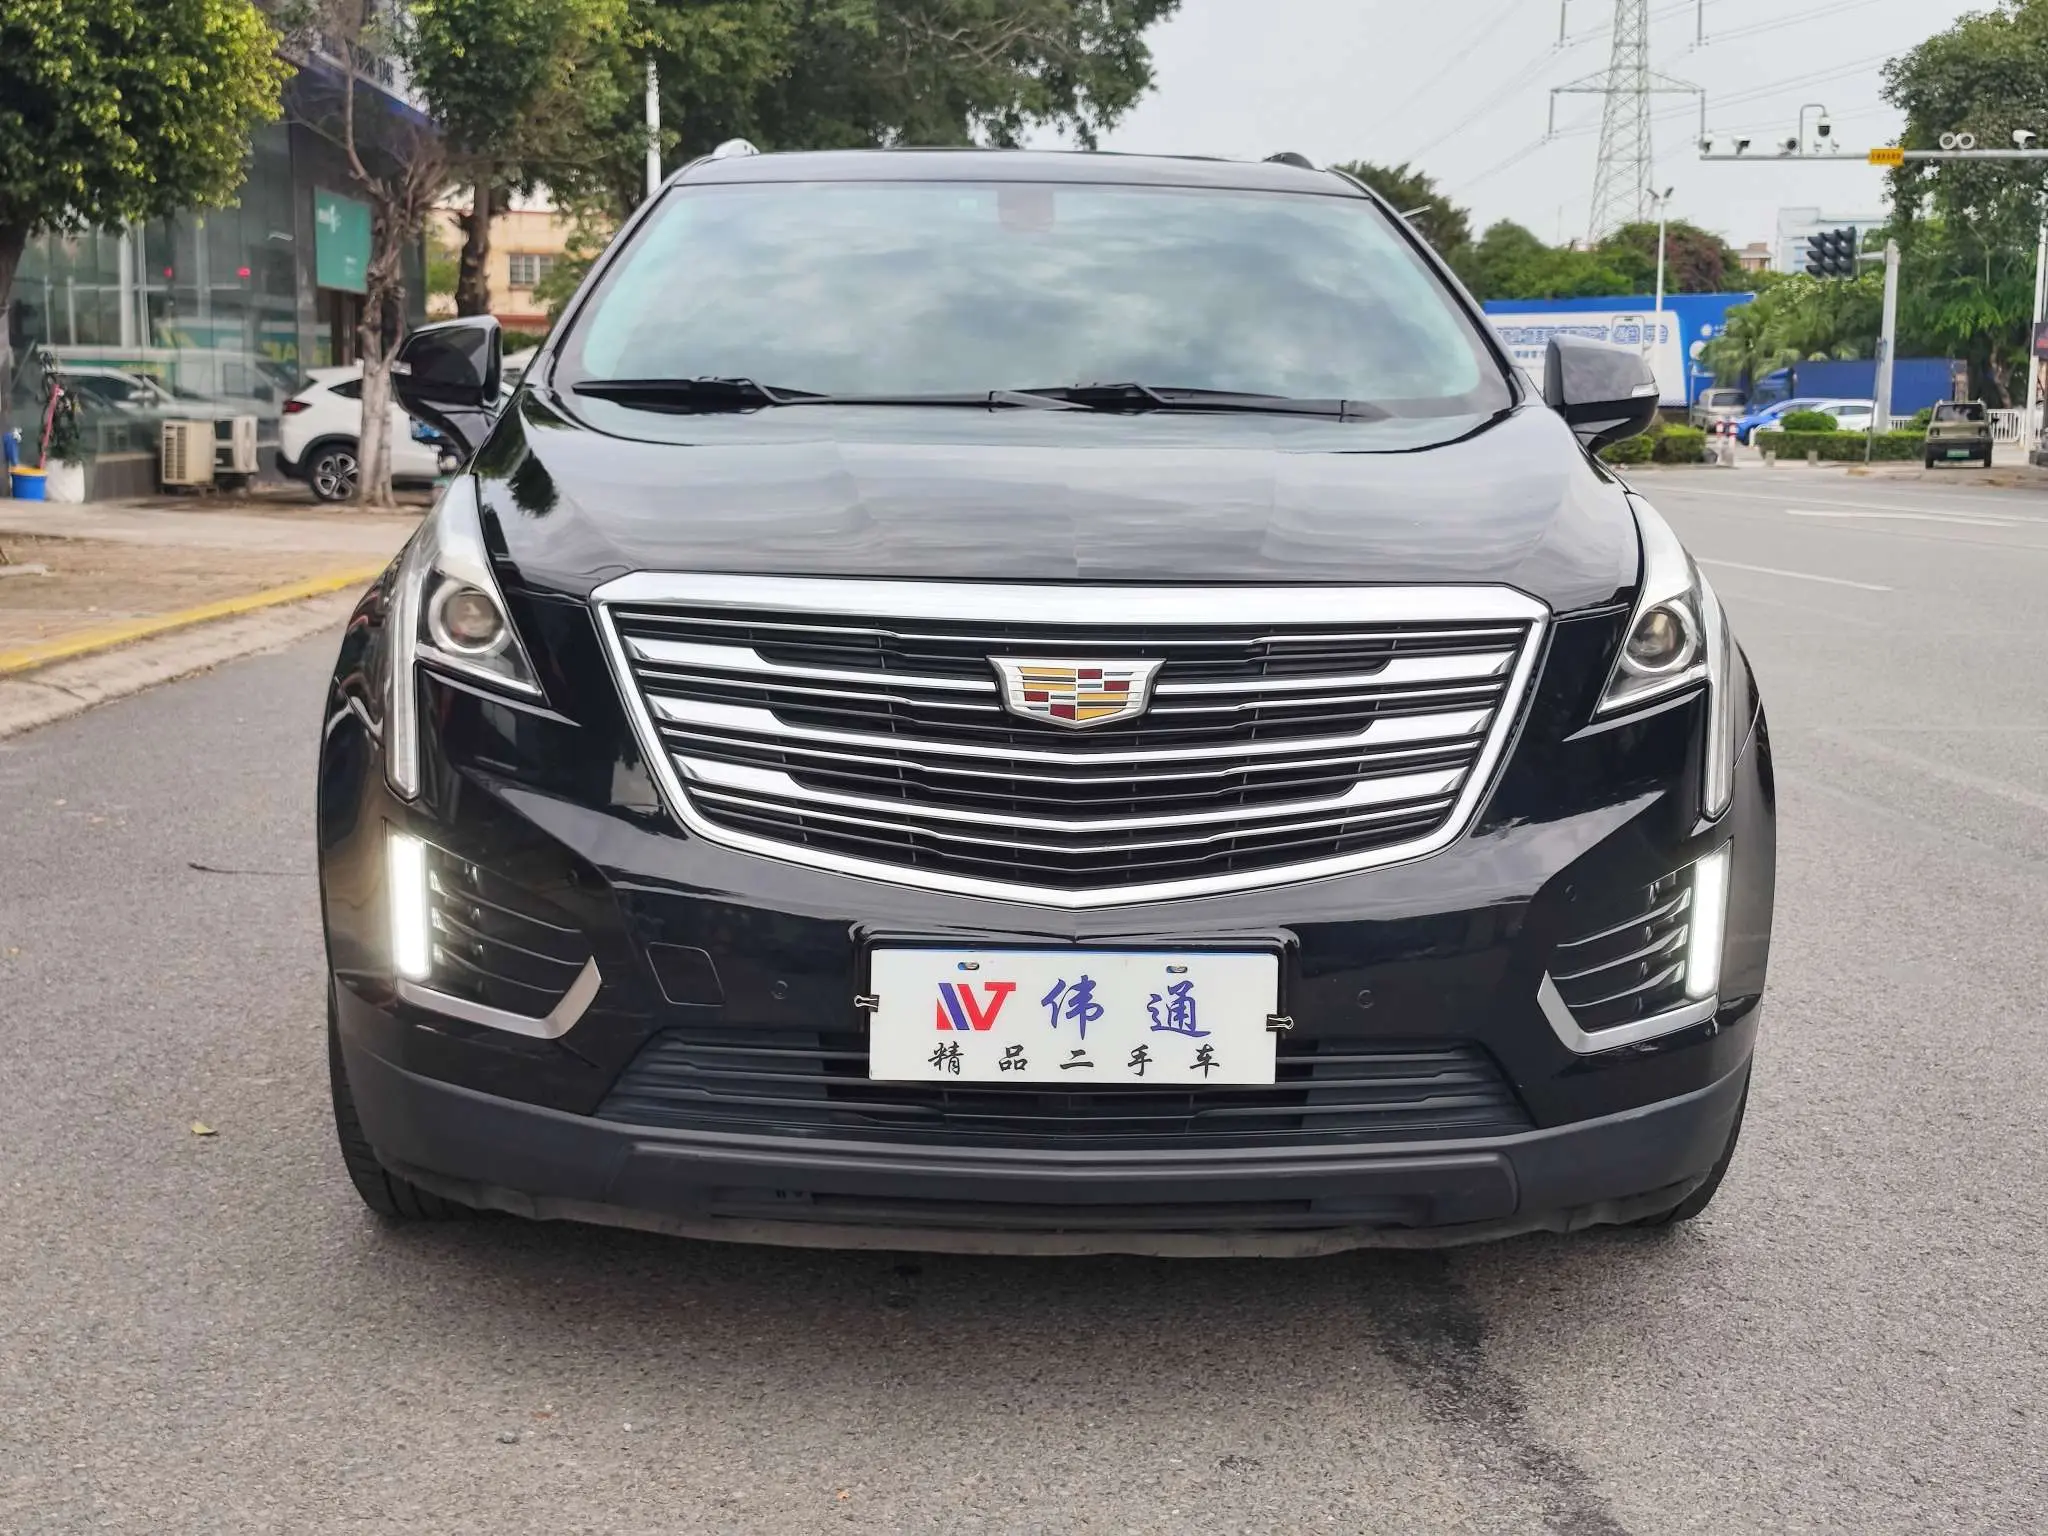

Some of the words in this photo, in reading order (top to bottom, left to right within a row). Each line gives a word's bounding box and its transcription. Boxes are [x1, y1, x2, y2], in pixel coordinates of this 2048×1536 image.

[1041, 975, 1212, 1040] 伟通
[928, 1041, 1220, 1078] 精品二手车
